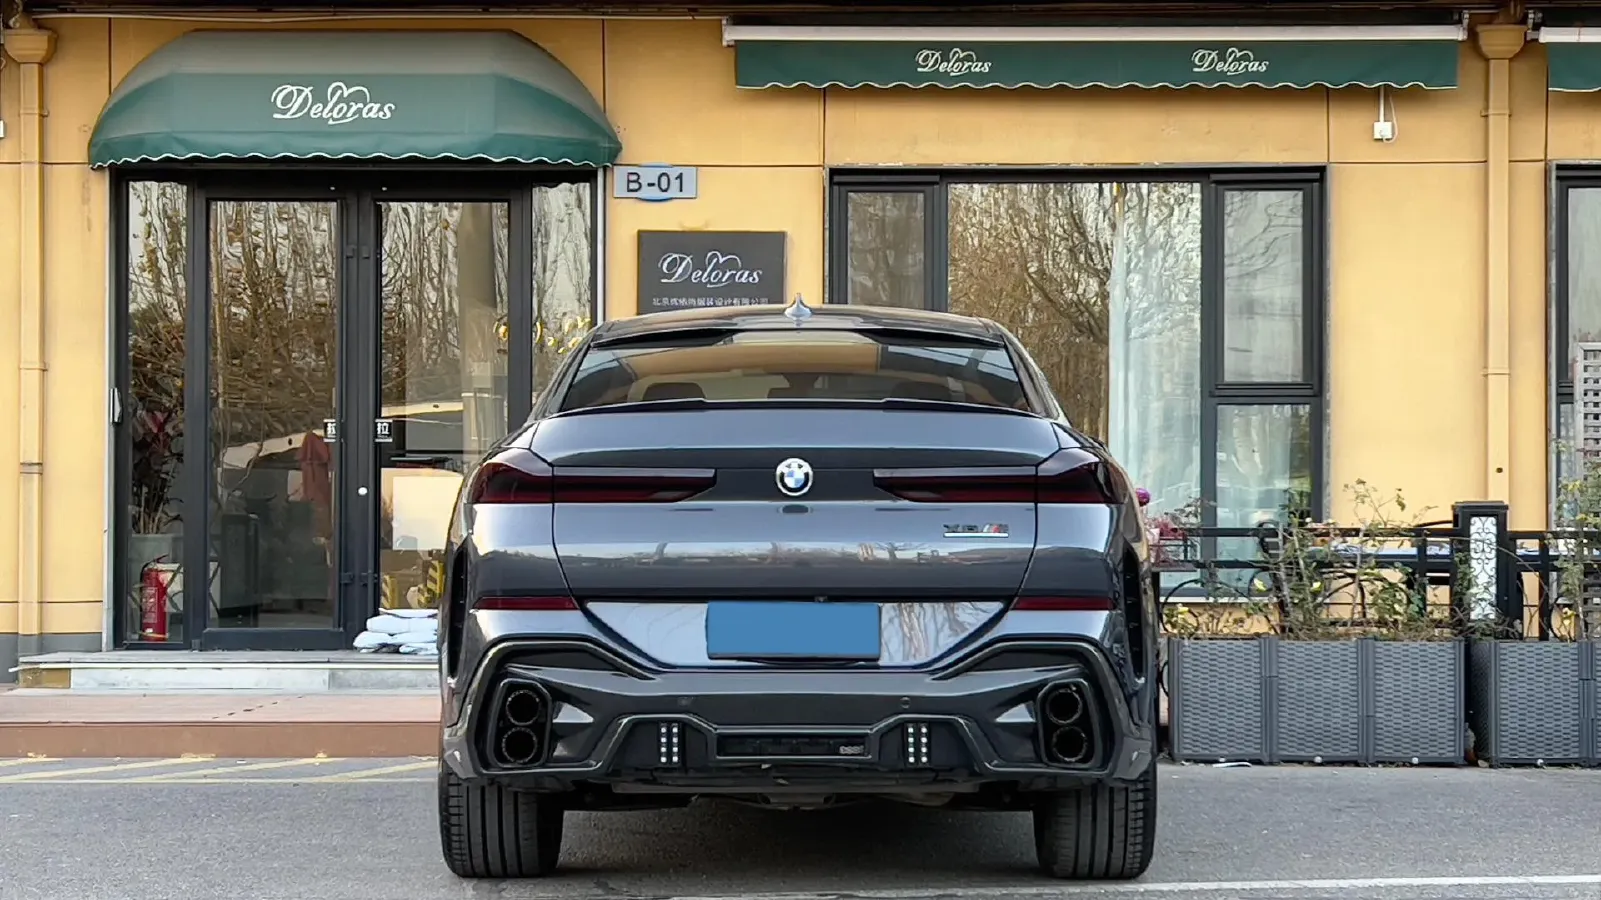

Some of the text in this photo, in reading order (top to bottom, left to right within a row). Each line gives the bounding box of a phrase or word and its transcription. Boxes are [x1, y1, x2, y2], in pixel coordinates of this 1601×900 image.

[915, 47, 992, 76] Deloras
[1191, 47, 1269, 76] Deloras
[271, 81, 396, 125] Deloras
[627, 172, 683, 192] B-01
[658, 250, 762, 288] Deloras
[376, 422, 389, 435] 拉
